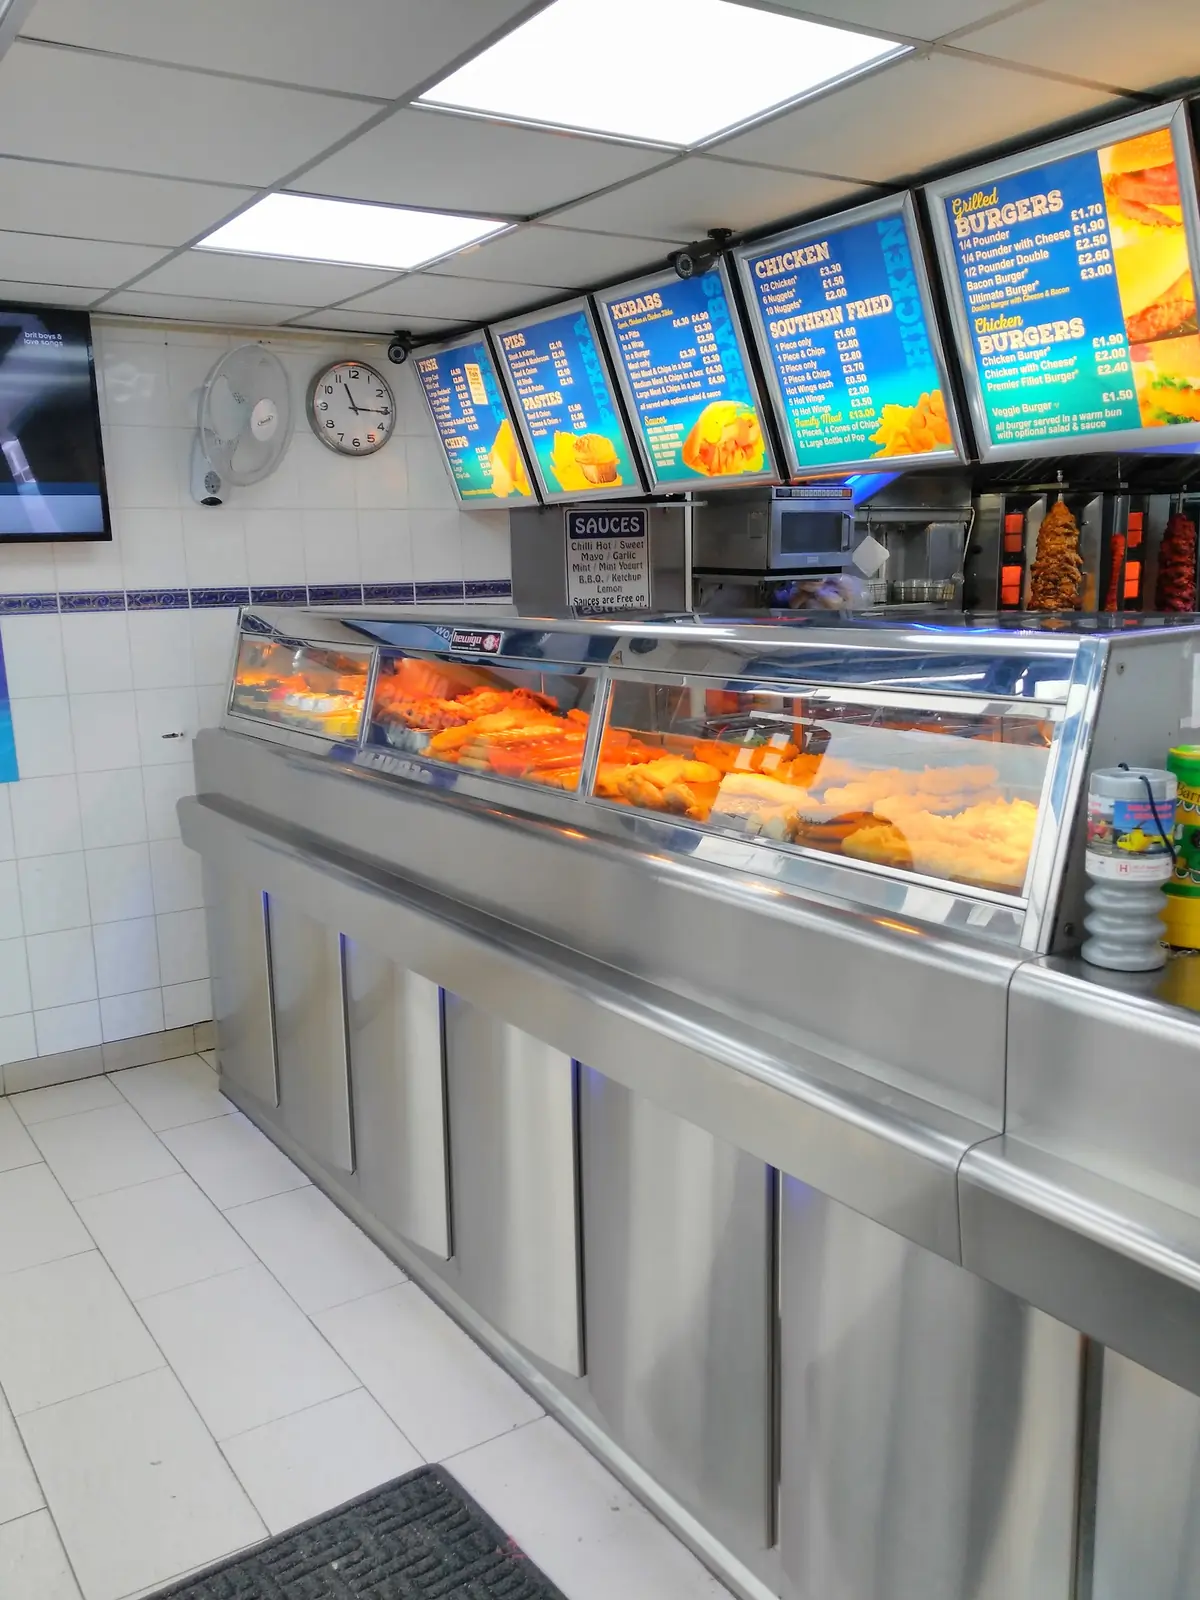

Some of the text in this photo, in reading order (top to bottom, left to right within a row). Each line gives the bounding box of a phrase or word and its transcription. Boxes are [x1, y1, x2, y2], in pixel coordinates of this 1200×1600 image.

[952, 187, 999, 219] Grilled
[955, 190, 1064, 238] BURGERS
[959, 204, 1102, 250] 1/4 Pounder £1.70
[962, 219, 1105, 264] 1/4 Pounder with Cheese £1.90
[755, 242, 831, 279] CHICKEN
[964, 234, 1107, 278] 1/2 Pounder Double £2.50
[820, 263, 842, 276] £3.30
[967, 278, 993, 291] Bacon
[1079, 249, 1109, 265] £2.60
[763, 296, 767, 304] 6
[822, 276, 844, 288] £1.50
[969, 289, 1004, 304] Ultimate
[1081, 264, 1112, 280] £3.00
[611, 293, 662, 319] KEBABS
[766, 307, 774, 315] 10
[825, 288, 847, 301] £2.00
[769, 294, 892, 338] SOUTHERN FRIED
[975, 314, 1023, 334] Chicken
[41, 340, 63, 348] songs
[503, 334, 526, 350] PIES
[780, 342, 797, 350] Piece
[798, 338, 812, 348] only
[978, 318, 1085, 355] BURGERS
[783, 353, 799, 361] Piece
[807, 346, 825, 357] Chips
[983, 353, 1016, 366] Chicken
[780, 366, 785, 374] 2
[786, 364, 802, 372] Piece
[804, 361, 817, 370] only
[985, 366, 1018, 379] Chicken
[1020, 362, 1039, 373] with
[1095, 348, 1126, 362] £2.00
[336, 375, 341, 383] 11
[349, 370, 359, 379] 12
[788, 375, 805, 383] Piece
[812, 369, 831, 381] Chips
[843, 362, 864, 373] £3.70
[987, 379, 1019, 391] Premier
[1021, 376, 1043, 386] Fillet
[1098, 362, 1128, 376] £2.40
[325, 386, 333, 394] 10
[786, 374, 867, 395] Hot Wings each £0.50
[376, 389, 383, 397] 2
[522, 391, 563, 410] PASTIES
[789, 385, 869, 406] 5 Hot Wings £2.00
[320, 402, 328, 411] 9
[381, 407, 390, 415] 3
[801, 406, 811, 415] Hot
[812, 403, 831, 414] Wings
[851, 397, 872, 407] £3.50
[992, 390, 1133, 417] Veggie Burger £1.50
[326, 420, 335, 428] 8
[377, 423, 384, 431] 4
[825, 426, 829, 434] 4
[830, 424, 850, 433] Cones
[852, 421, 858, 430] of
[860, 418, 880, 430] Chips
[996, 422, 1005, 431] all
[1006, 417, 1032, 431] burger
[1034, 414, 1061, 426] served
[1063, 413, 1070, 422] in
[1079, 410, 1103, 420] warm
[1105, 408, 1122, 417] bun
[337, 433, 344, 441] 7
[997, 421, 1106, 439] with optional salad & sauce
[352, 439, 360, 447] 6
[367, 435, 375, 443] 5
[806, 437, 823, 448] Large
[824, 435, 842, 445] Bottle
[844, 434, 850, 442] of
[851, 433, 865, 442] Pop
[575, 517, 640, 534] SAUCES
[571, 542, 593, 550] Chilli
[596, 541, 611, 550] Hot
[620, 541, 644, 549] Sweet
[581, 553, 604, 561] Mayo
[613, 552, 636, 560] Garlic
[573, 563, 590, 572] Mint
[599, 563, 616, 571] Mint
[619, 562, 643, 570] Yogurt
[579, 575, 604, 584] B.B.Q.
[612, 573, 641, 582] Ketchup
[597, 585, 622, 593] Lemon
[573, 597, 599, 606] Sauces
[617, 595, 633, 603] Free
